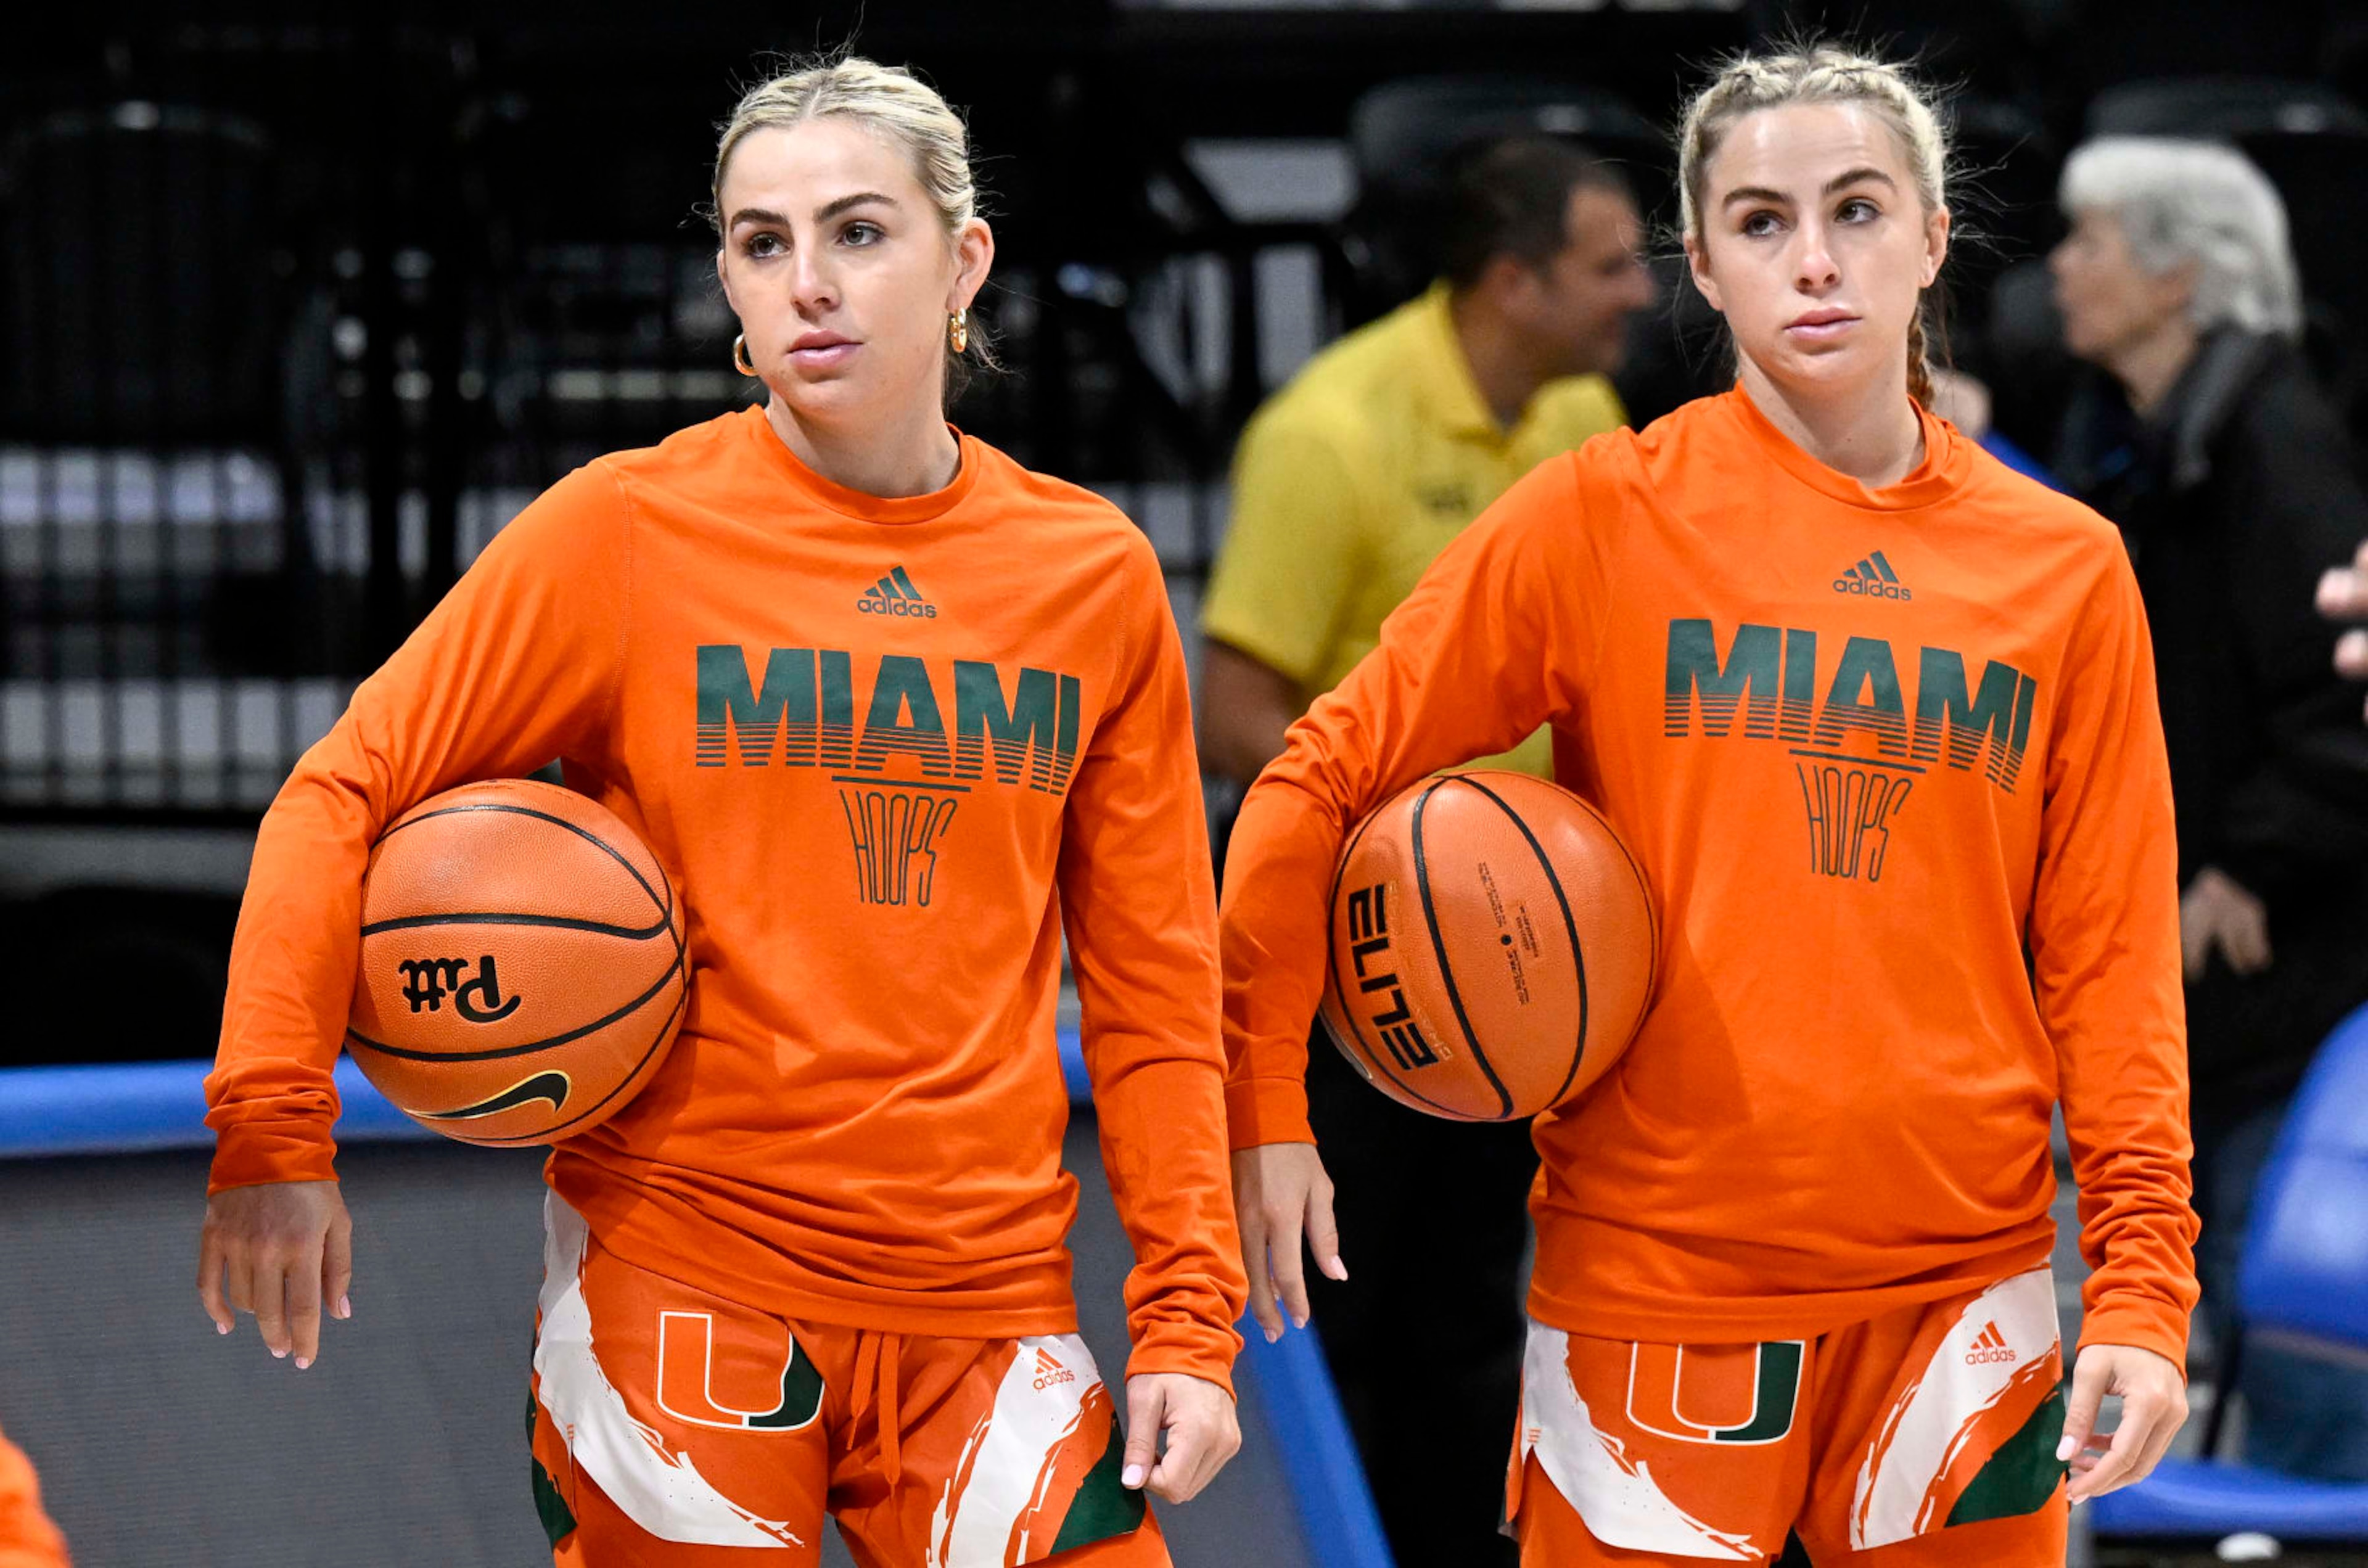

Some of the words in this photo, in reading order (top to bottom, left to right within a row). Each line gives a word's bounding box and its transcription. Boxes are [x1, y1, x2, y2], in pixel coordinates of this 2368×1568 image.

[857, 595, 937, 618] adidas
[1833, 578, 1911, 601] adidas
[696, 645, 1080, 796] MIAMI
[1664, 619, 2037, 795] MIAMI
[839, 789, 957, 907] HOOPS
[1796, 763, 1912, 882] HOOPS
[398, 954, 520, 1024] Pitt
[1348, 884, 1439, 1070] ELITE
[659, 1310, 825, 1432] U
[1033, 1369, 1074, 1390] adidas
[1626, 1340, 1806, 1445] U
[1965, 1348, 2016, 1365] adidas
